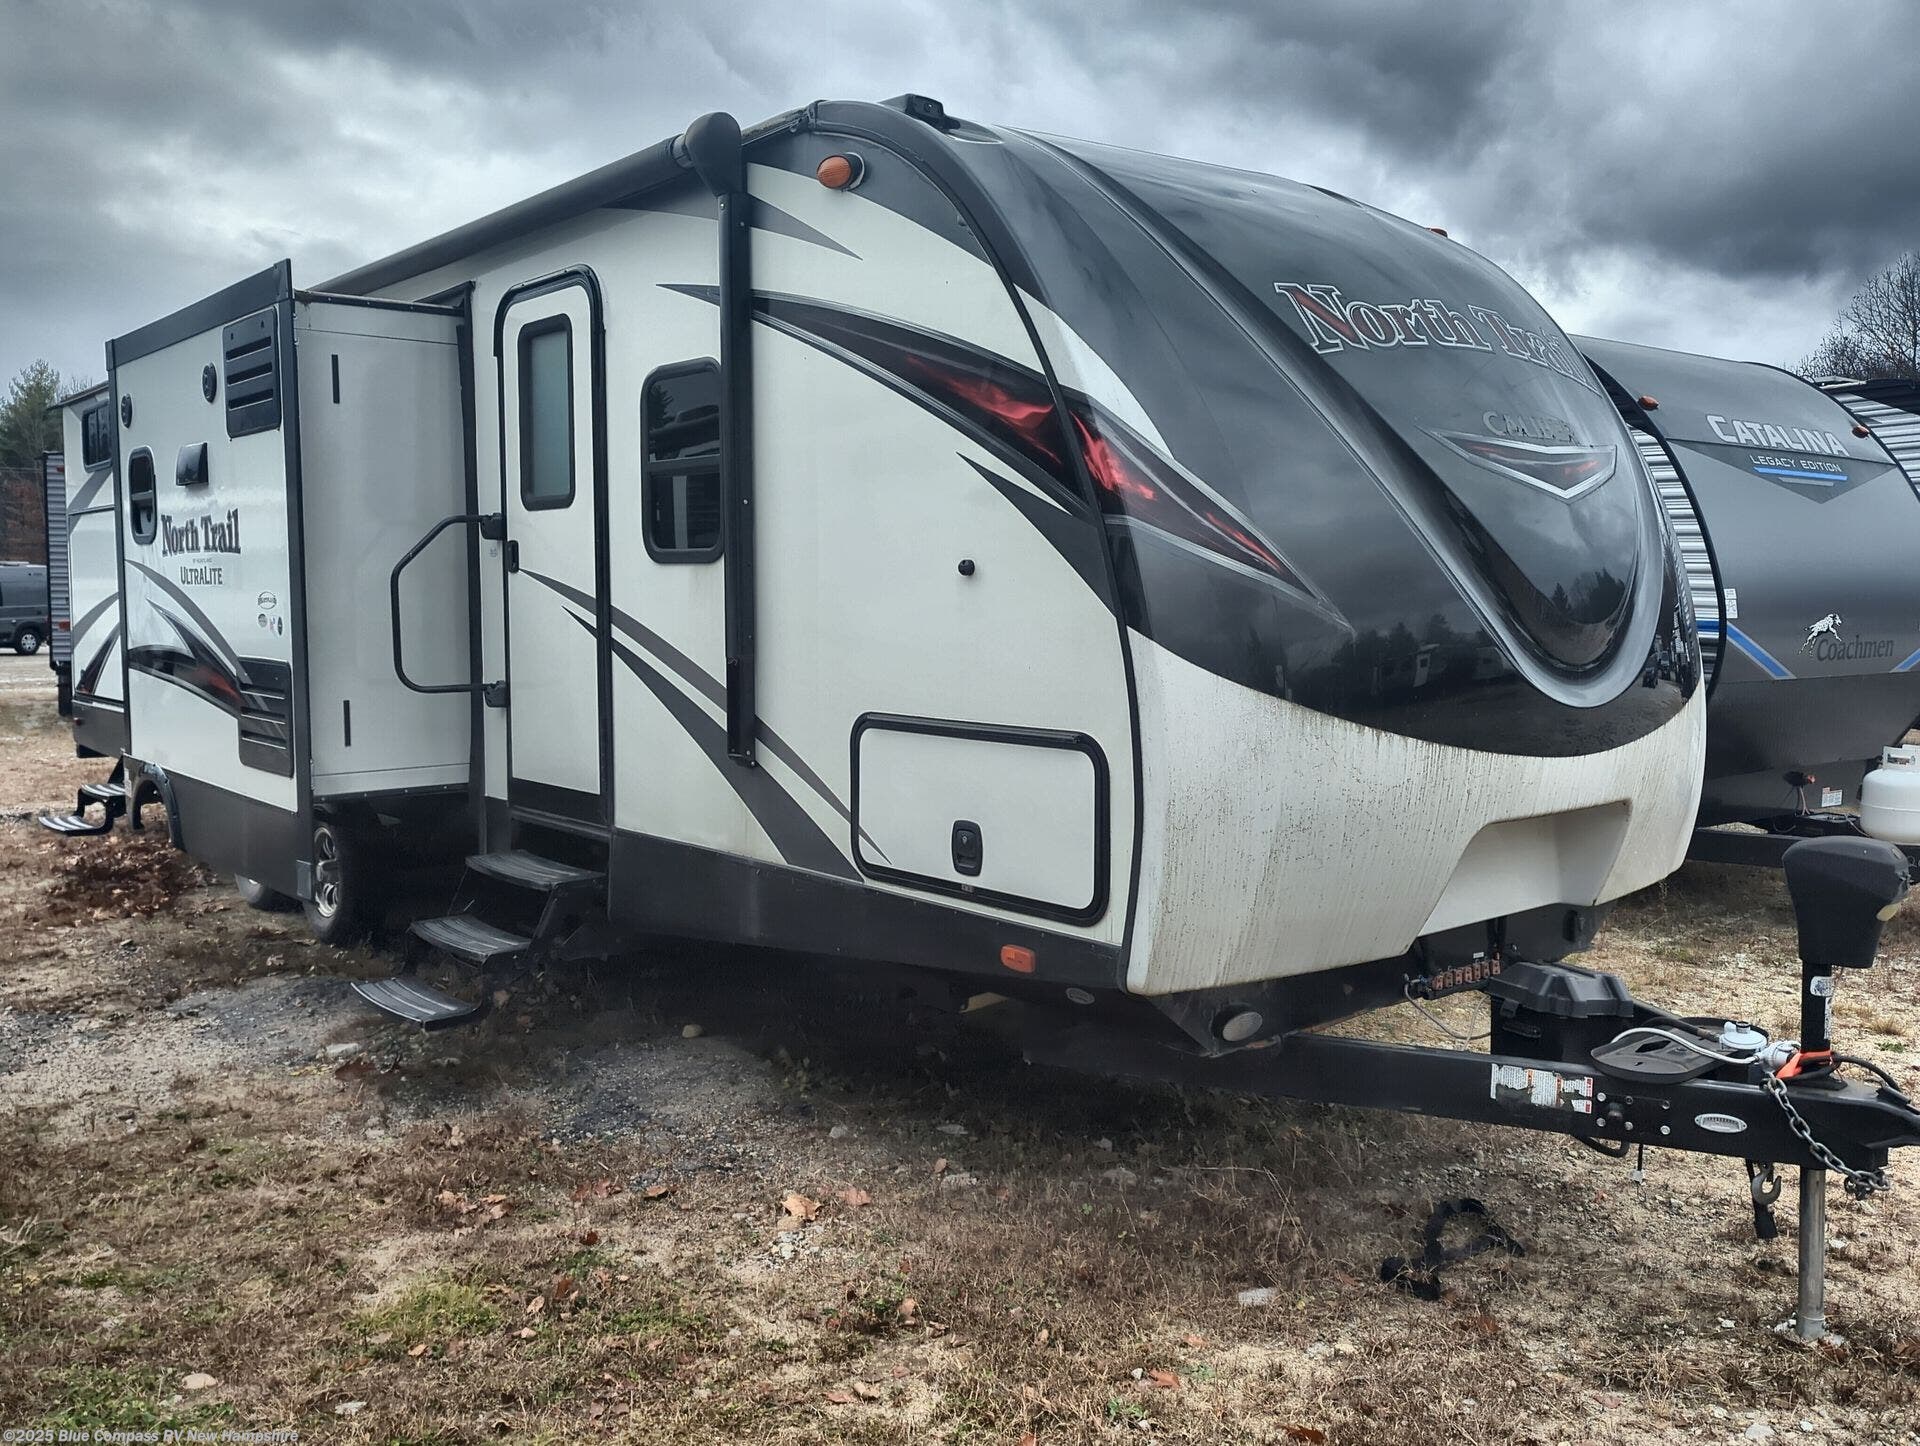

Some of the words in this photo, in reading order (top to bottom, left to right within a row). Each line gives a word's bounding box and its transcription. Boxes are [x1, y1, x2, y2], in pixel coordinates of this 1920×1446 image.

[1273, 282, 1495, 355] North
[1468, 304, 1604, 399] Trail
[1706, 414, 1850, 456] CATALINA
[1750, 454, 1796, 468] LEGACY
[1801, 459, 1842, 472] EDITION
[160, 514, 201, 557] North
[200, 508, 241, 554] Trail
[1816, 634, 1895, 662] Coachmen
